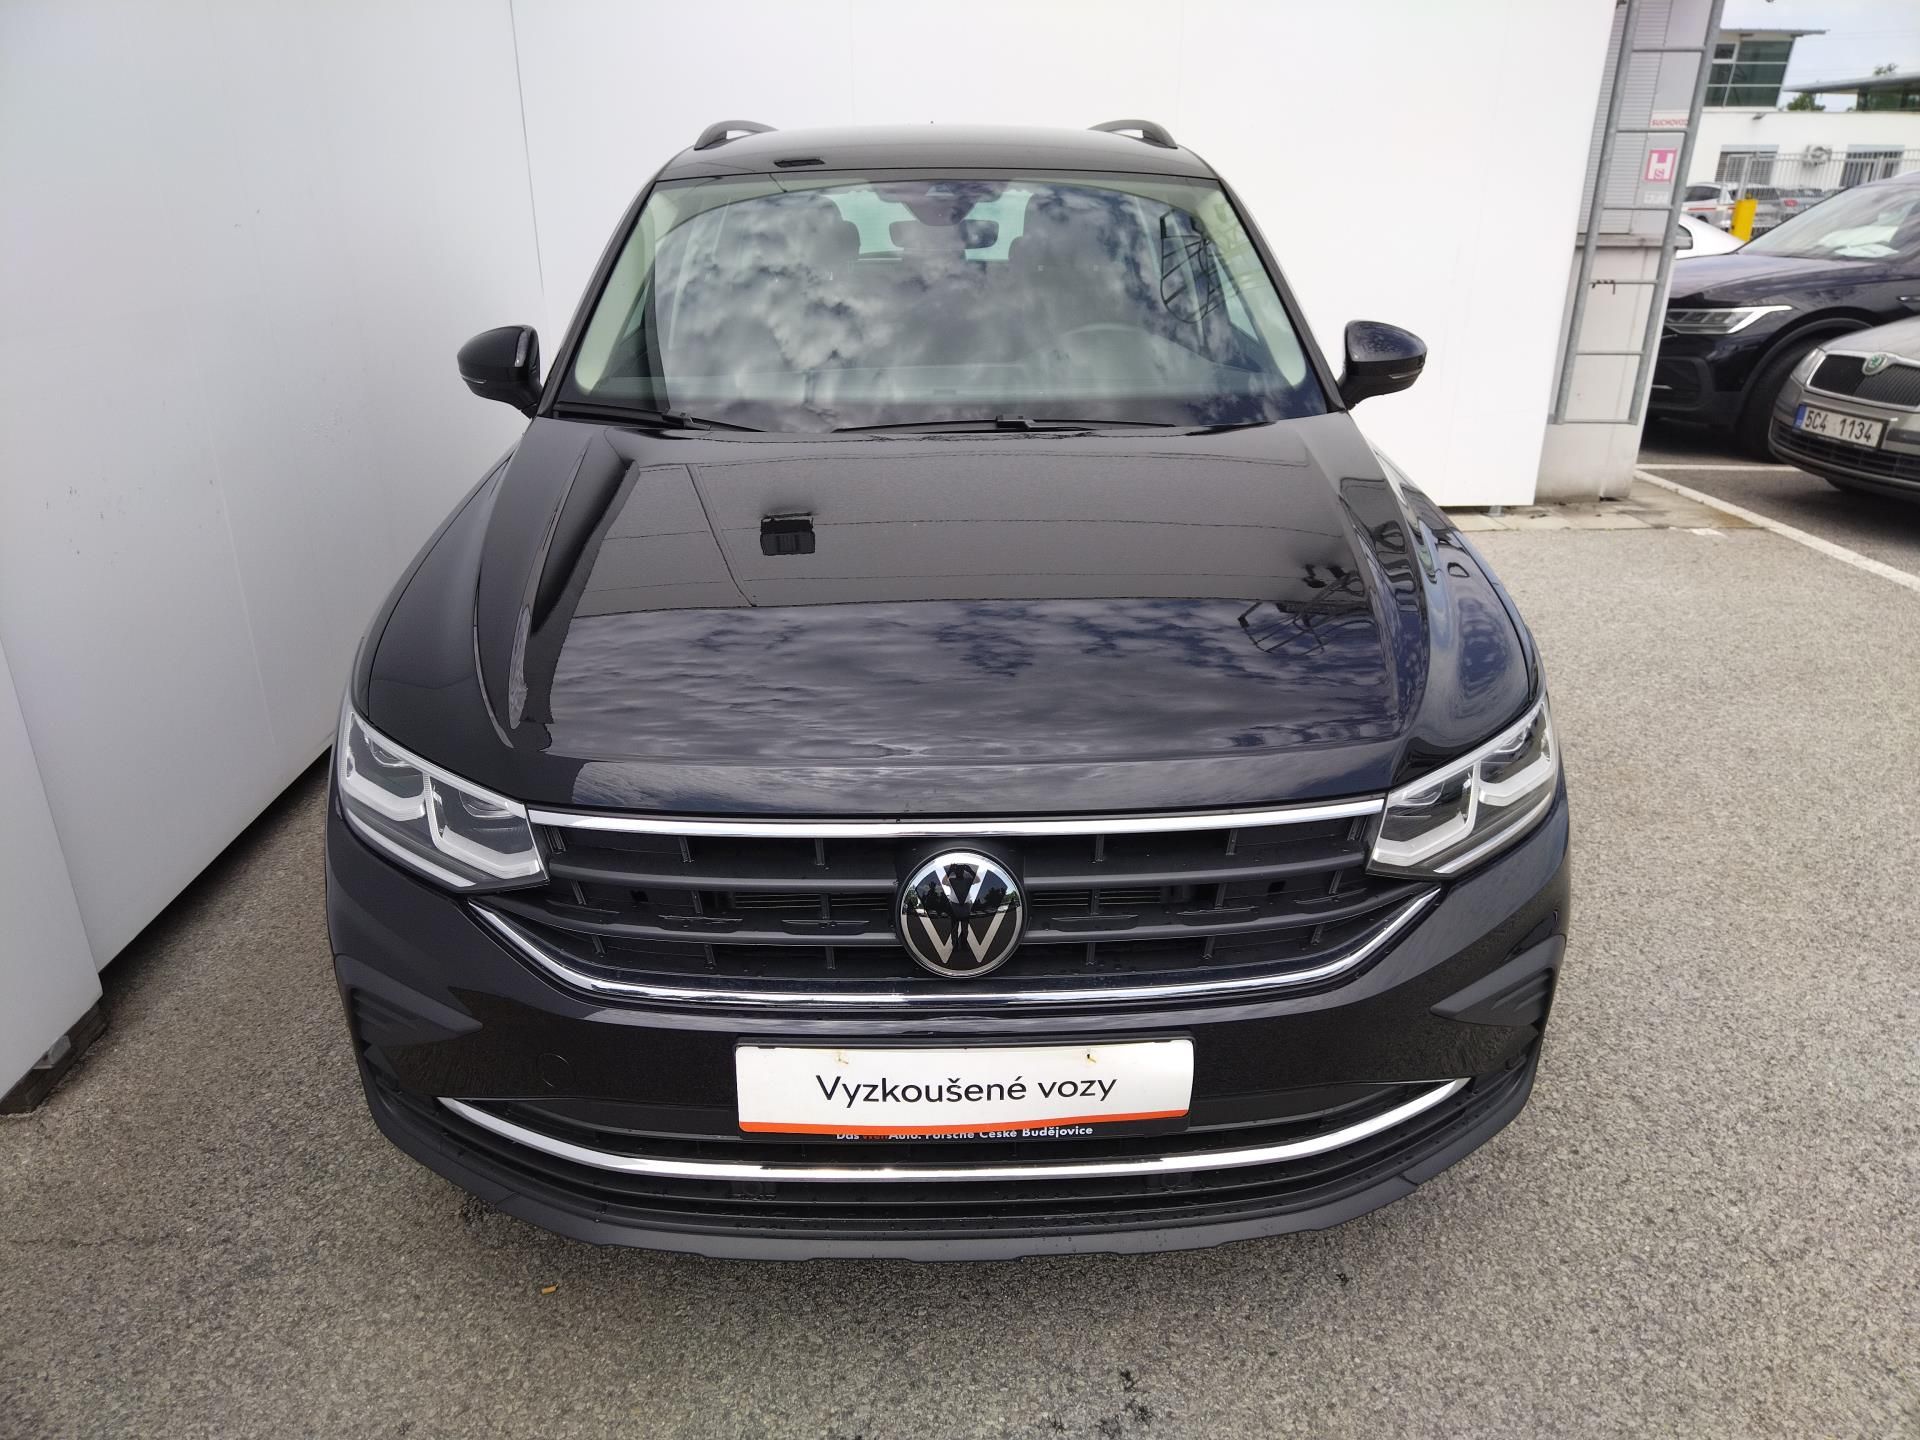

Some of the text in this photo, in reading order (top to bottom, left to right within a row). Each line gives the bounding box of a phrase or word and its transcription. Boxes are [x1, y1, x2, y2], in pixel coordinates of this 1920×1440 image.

[1804, 410, 1829, 433] 5C4
[1839, 418, 1873, 443] 1134
[815, 1075, 1118, 1108] Vyzkoušené vozy
[1022, 1125, 1094, 1138] Budějovice
